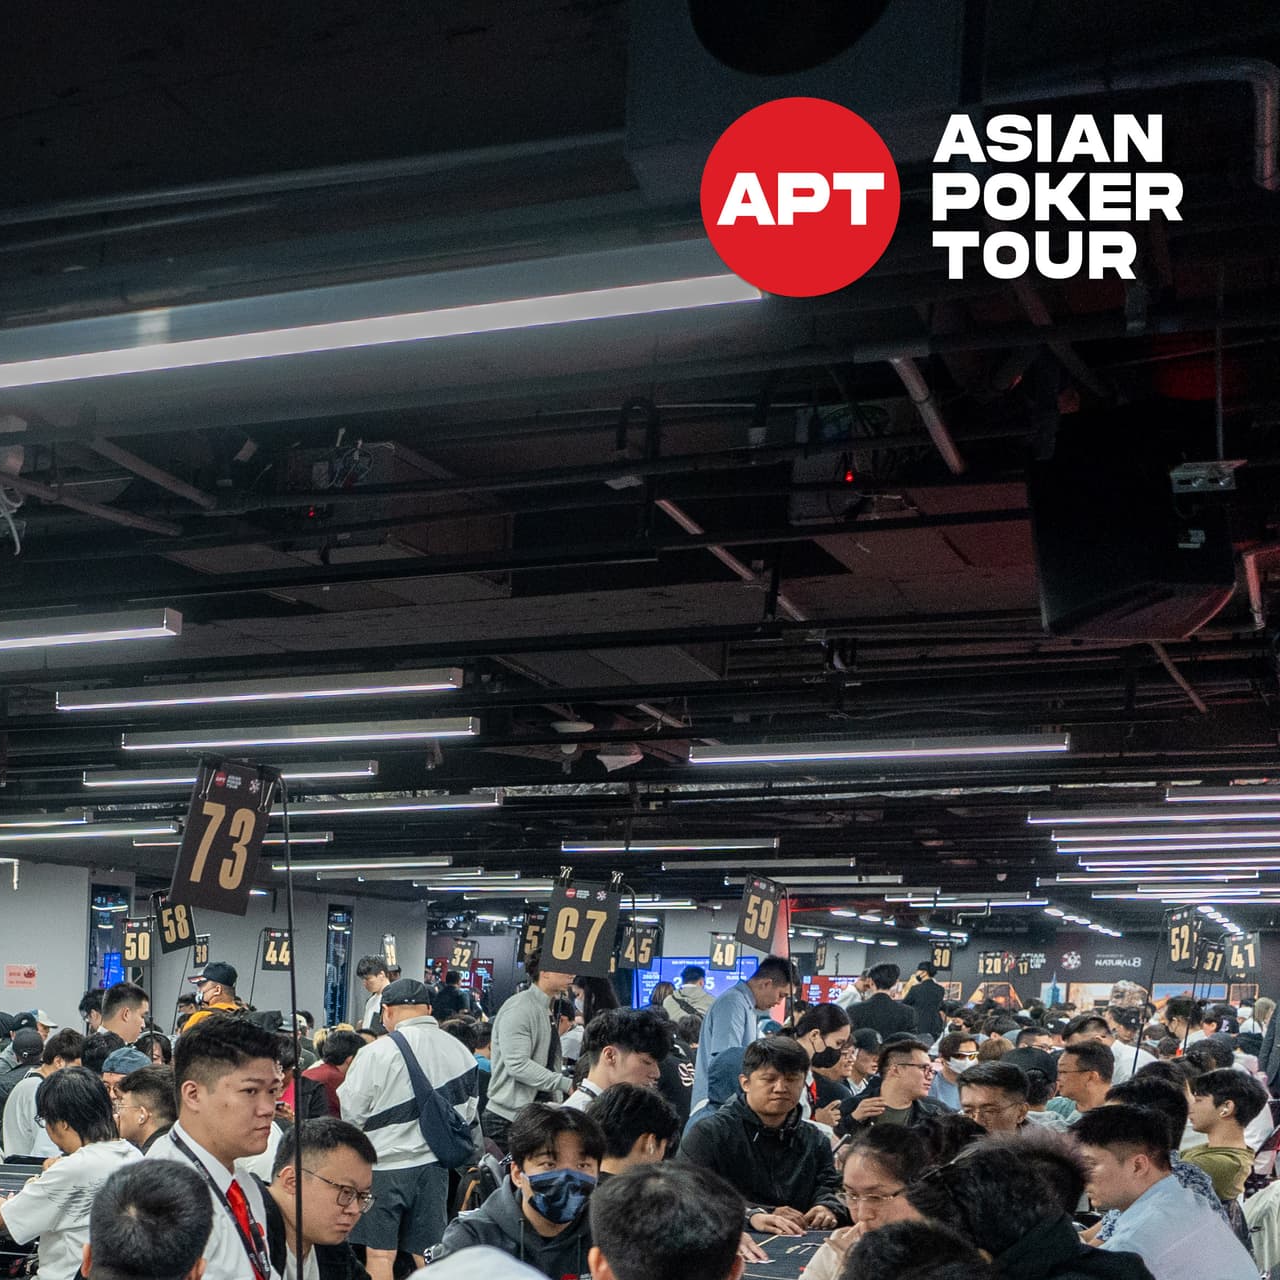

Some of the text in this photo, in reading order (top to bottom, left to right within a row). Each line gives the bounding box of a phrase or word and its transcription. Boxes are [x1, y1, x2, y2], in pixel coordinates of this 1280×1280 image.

[189, 802, 256, 890] 73
[161, 904, 190, 944] 58
[744, 894, 774, 940] 59
[124, 932, 151, 961] 50
[552, 907, 608, 962] 67
[1171, 925, 1190, 962] 52
[265, 941, 290, 966] 44
[451, 948, 471, 967] 32
[624, 937, 653, 964] 45
[712, 943, 735, 966] 40
[933, 948, 951, 968] 30
[1203, 951, 1223, 972] 31
[1230, 943, 1255, 969] 41
[985, 957, 1001, 974] 20
